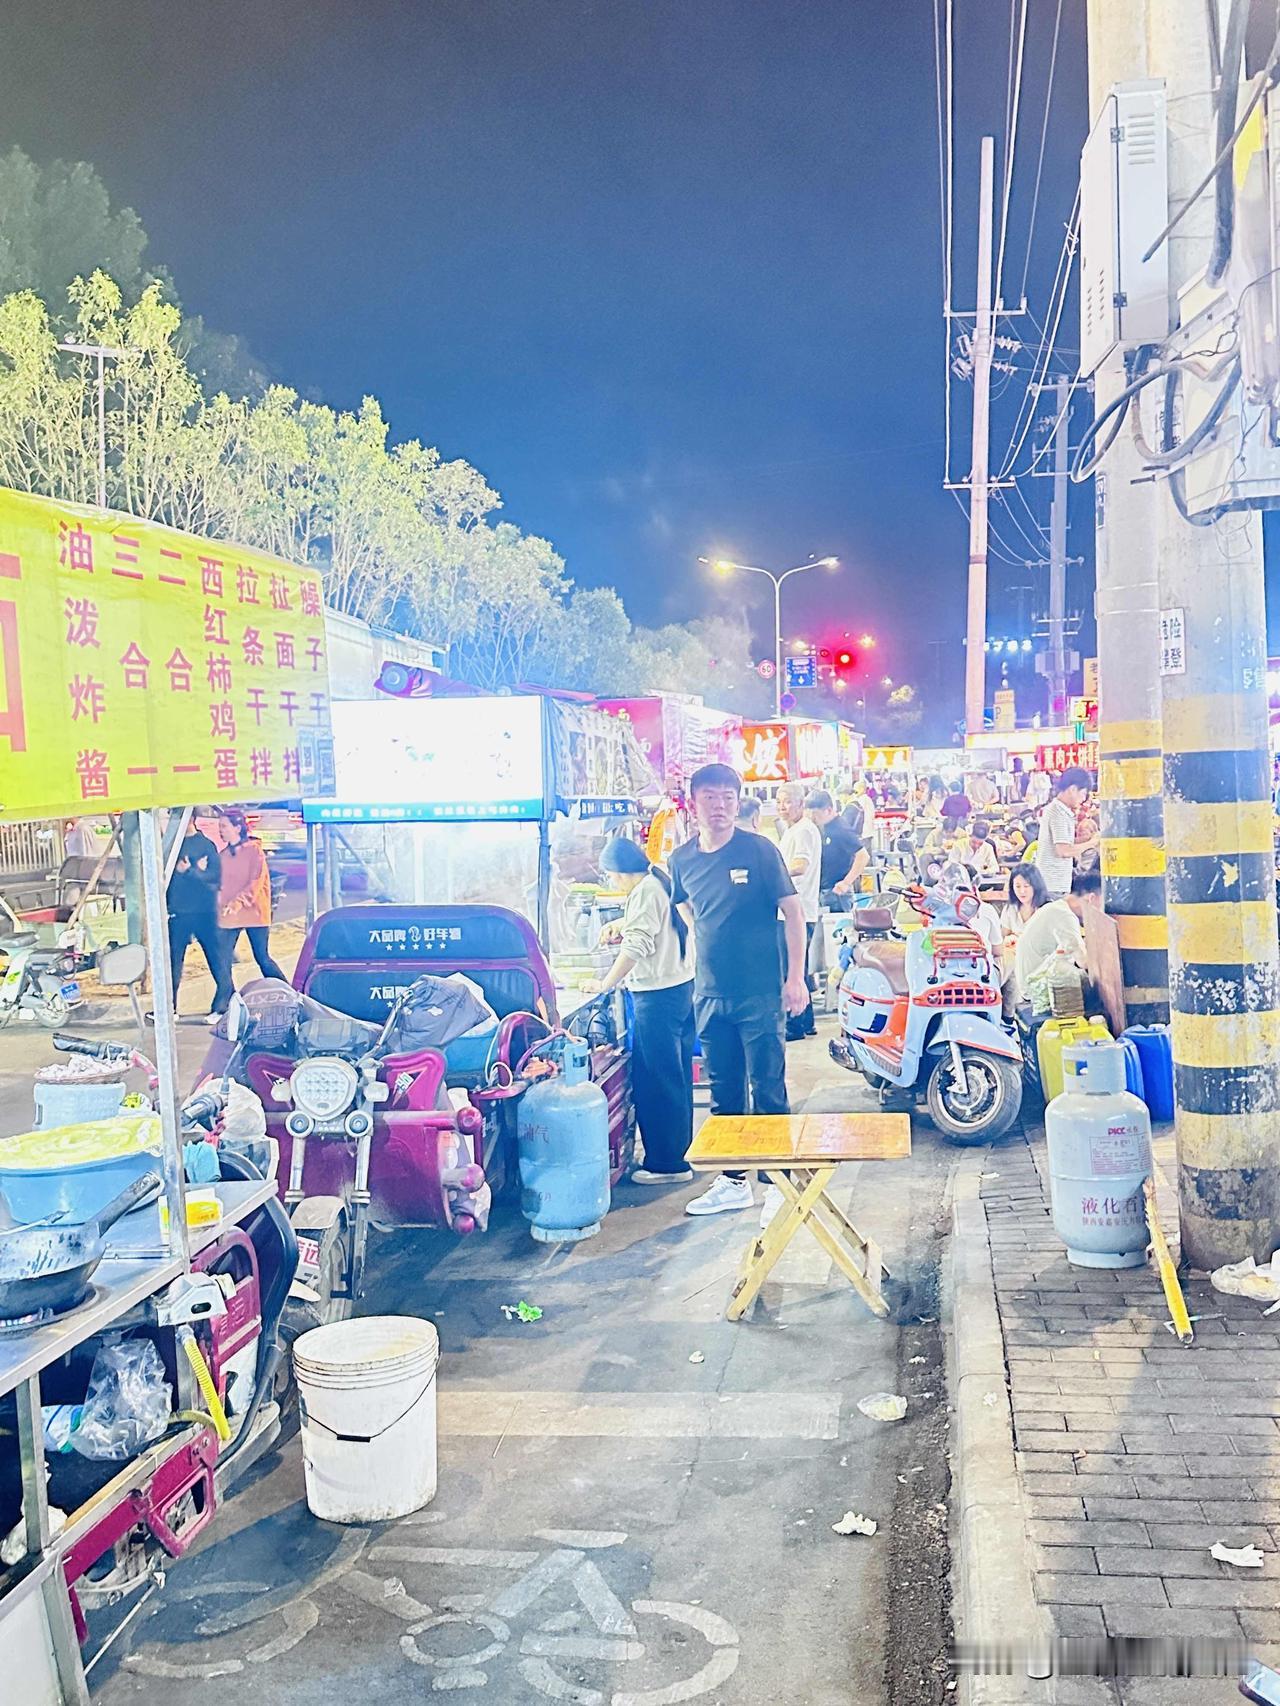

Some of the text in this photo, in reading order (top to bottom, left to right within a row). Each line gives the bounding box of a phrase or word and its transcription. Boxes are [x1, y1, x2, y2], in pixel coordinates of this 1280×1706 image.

[58, 520, 110, 799] 油泼炸酱
[111, 535, 158, 775] 三合一
[158, 548, 201, 773] 二合一
[197, 556, 239, 789] 西红柿鸡蛋
[236, 564, 272, 786] 拉条干拌
[1082, 1196, 1147, 1215] 液化石
